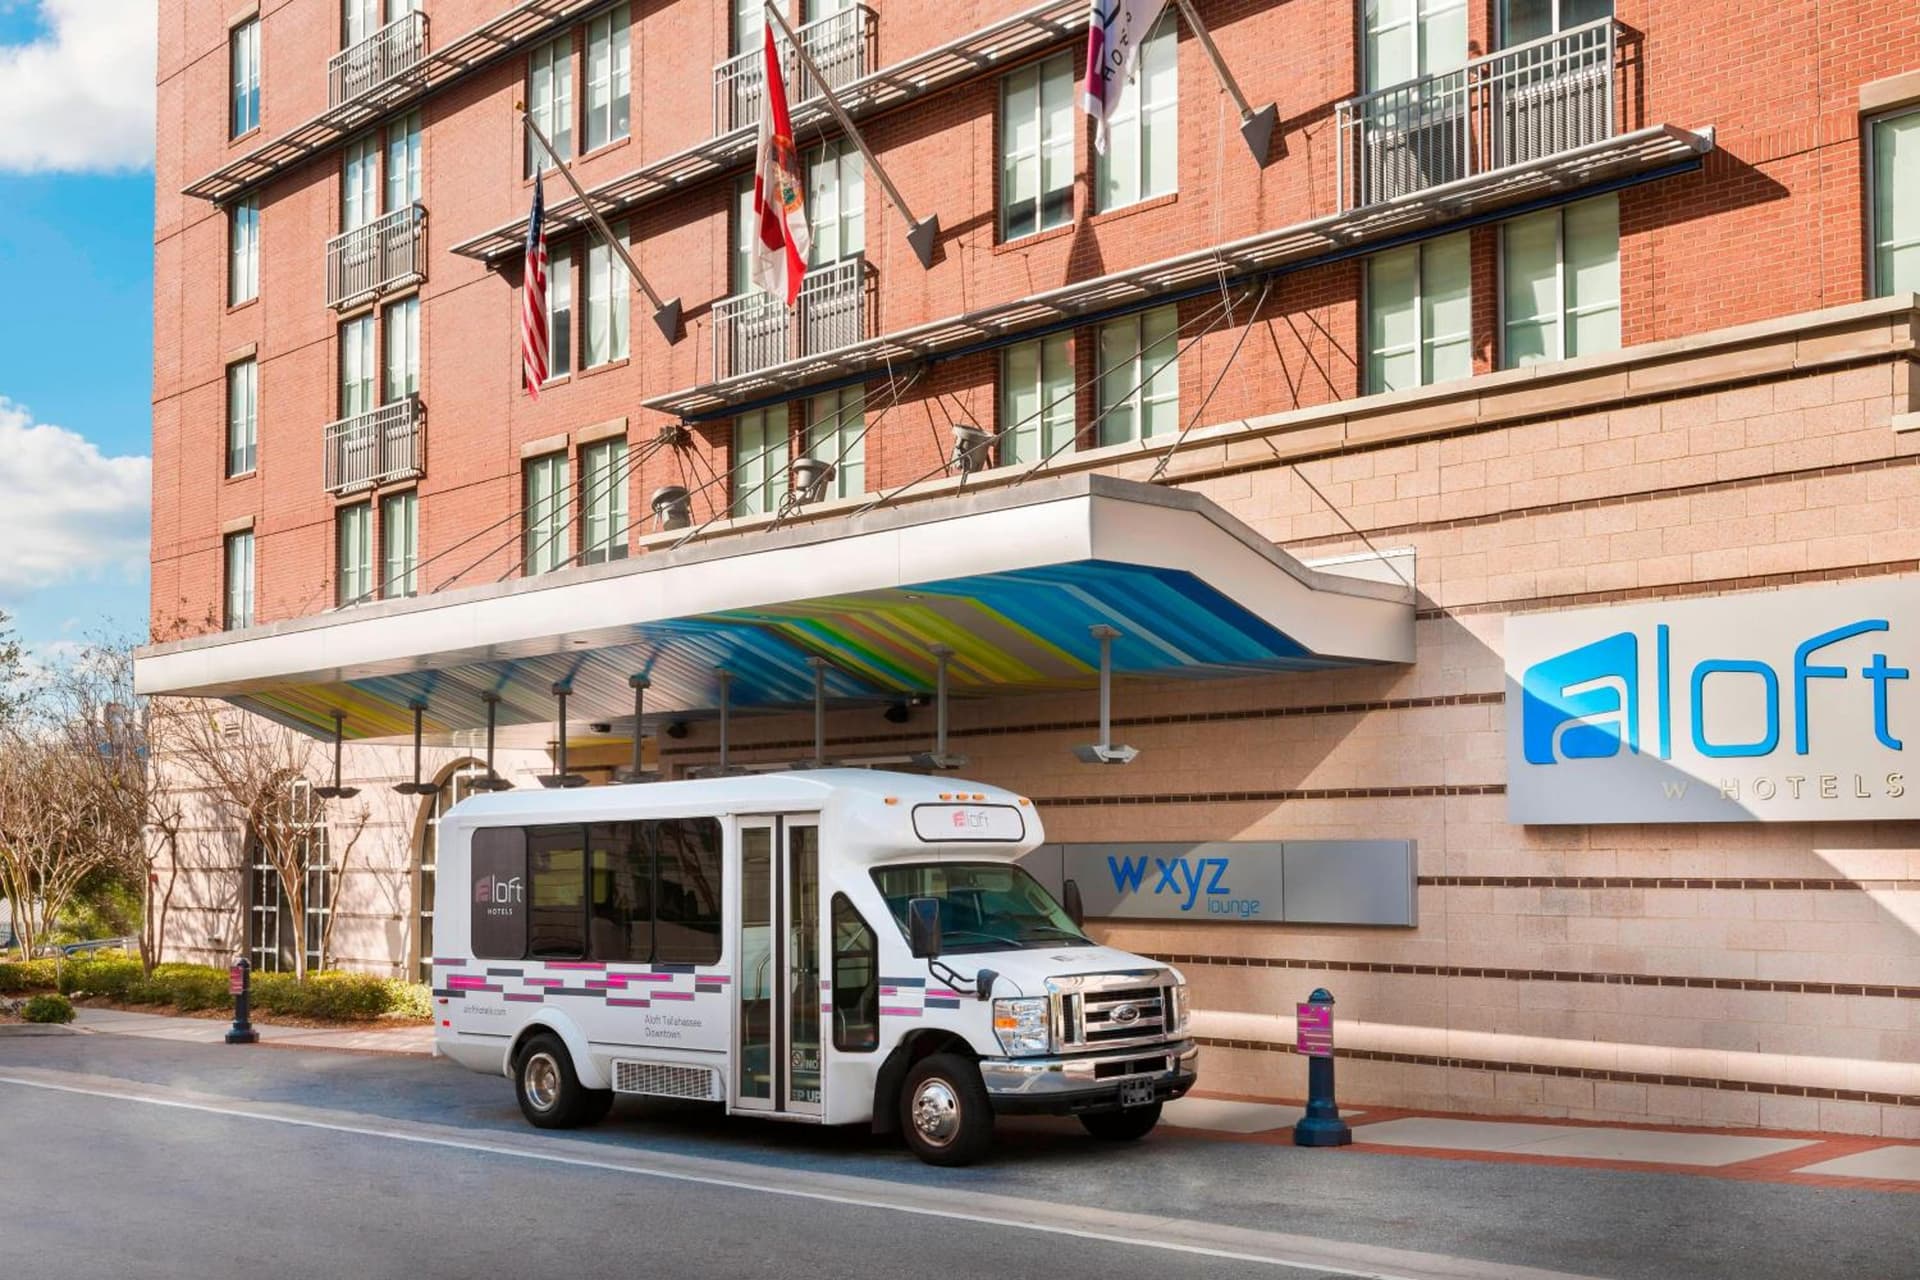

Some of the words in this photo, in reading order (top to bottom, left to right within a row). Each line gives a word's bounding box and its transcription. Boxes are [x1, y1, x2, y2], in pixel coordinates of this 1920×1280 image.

[1523, 618, 1909, 765] aloft
[1662, 781, 1688, 801] W
[1719, 772, 1905, 801] HOTELS
[475, 874, 524, 903] aloft
[487, 907, 513, 916] HOTELS
[1207, 896, 1261, 918] lounge
